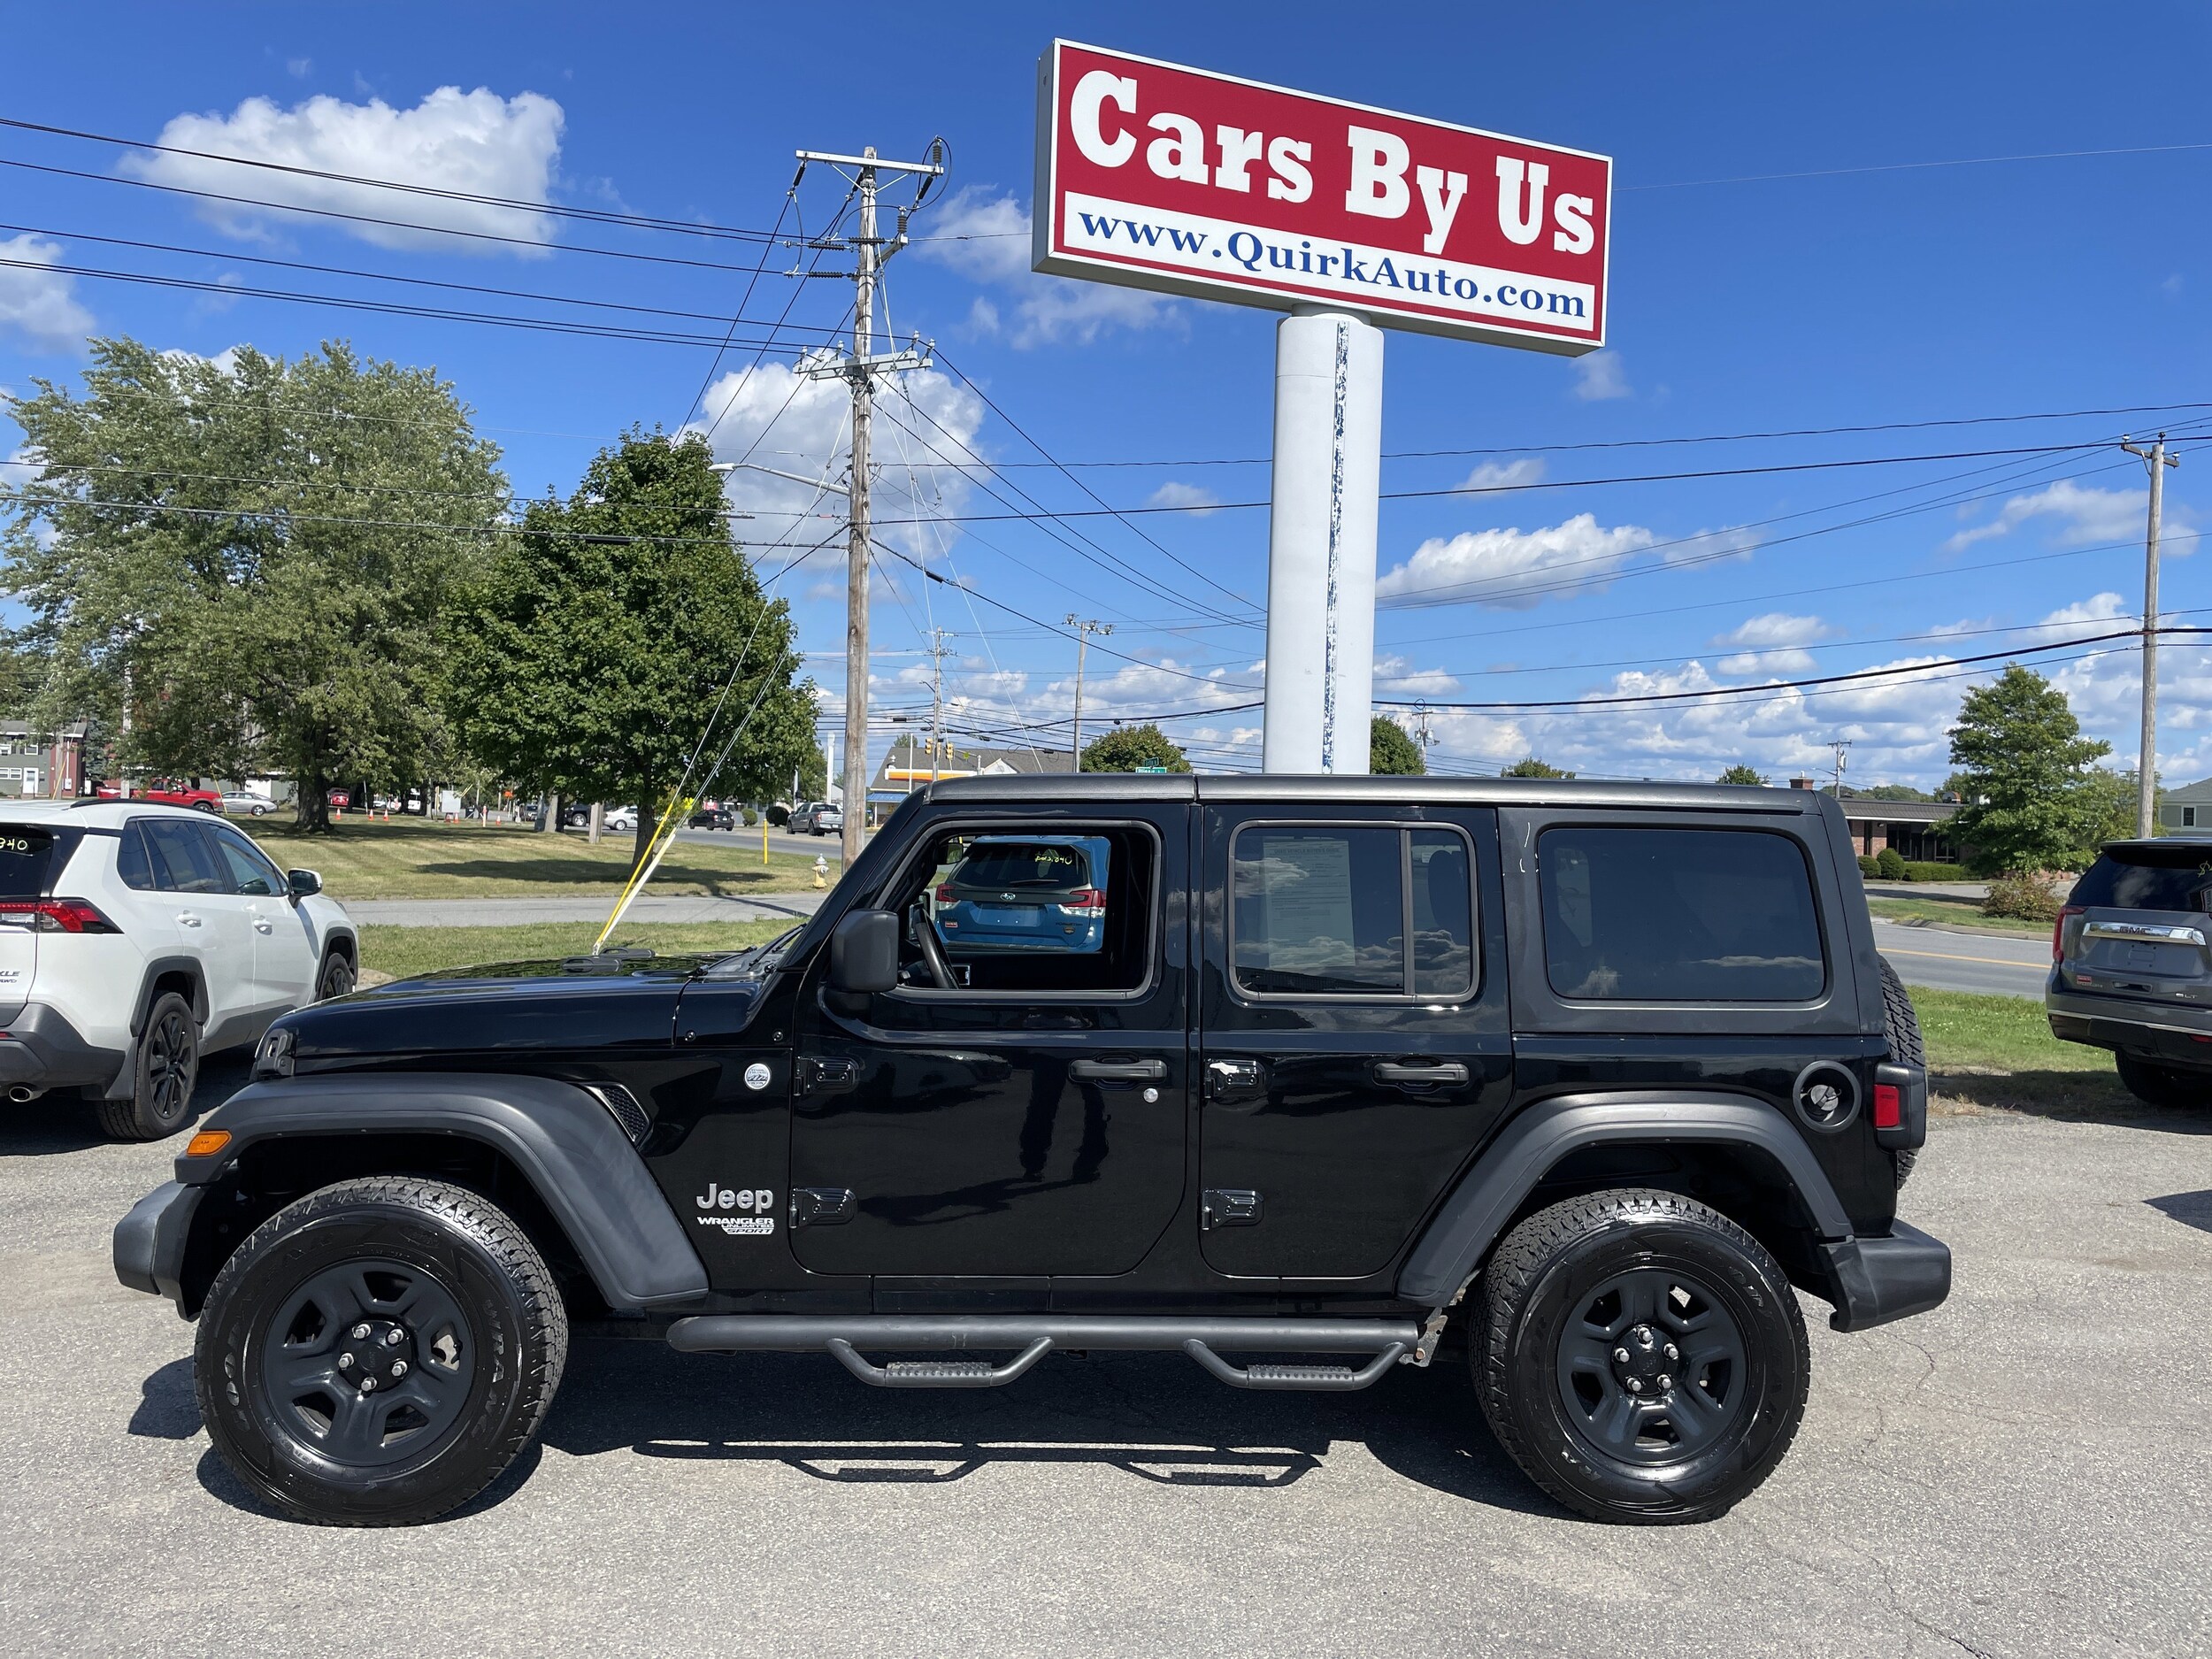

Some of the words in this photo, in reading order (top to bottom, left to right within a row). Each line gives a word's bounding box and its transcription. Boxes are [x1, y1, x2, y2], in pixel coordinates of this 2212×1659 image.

[1070, 70, 1313, 204] Cars
[1345, 124, 1468, 254] By
[1494, 156, 1595, 255] Us
[1079, 211, 1586, 319] www.QuirkAuto.com
[2119, 926, 2154, 934] GMC
[696, 1183, 773, 1214] Jeep
